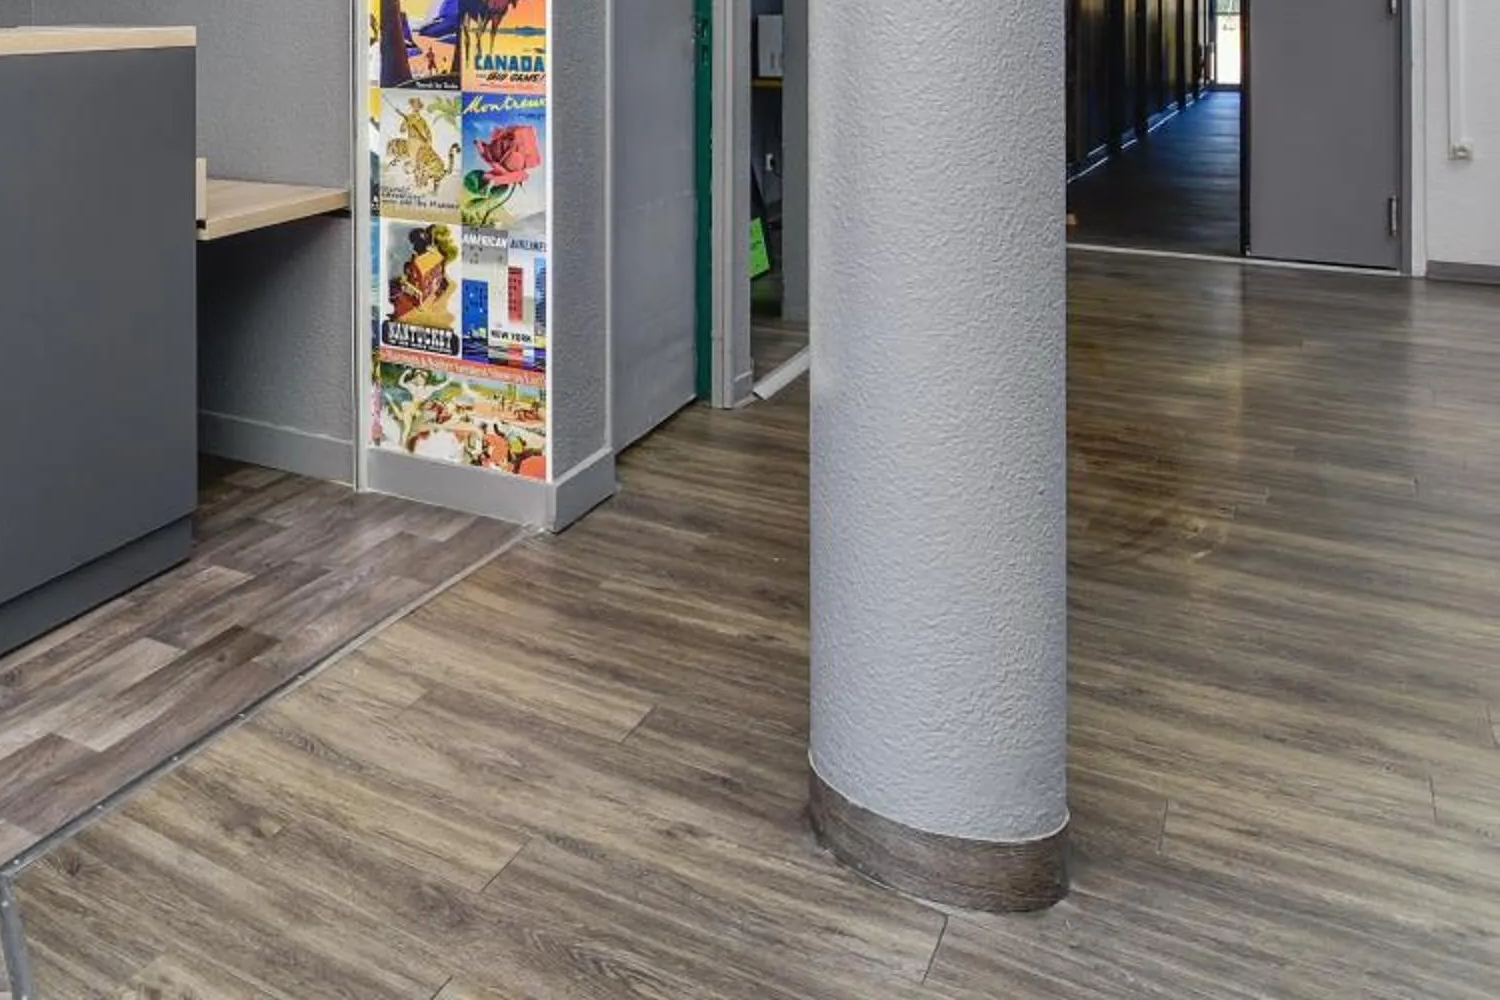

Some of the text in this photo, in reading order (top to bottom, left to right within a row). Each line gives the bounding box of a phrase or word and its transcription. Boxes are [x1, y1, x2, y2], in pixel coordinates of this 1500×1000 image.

[474, 55, 545, 72] CANADA
[462, 233, 508, 249] AMERICAN
[511, 333, 532, 342] YORK
